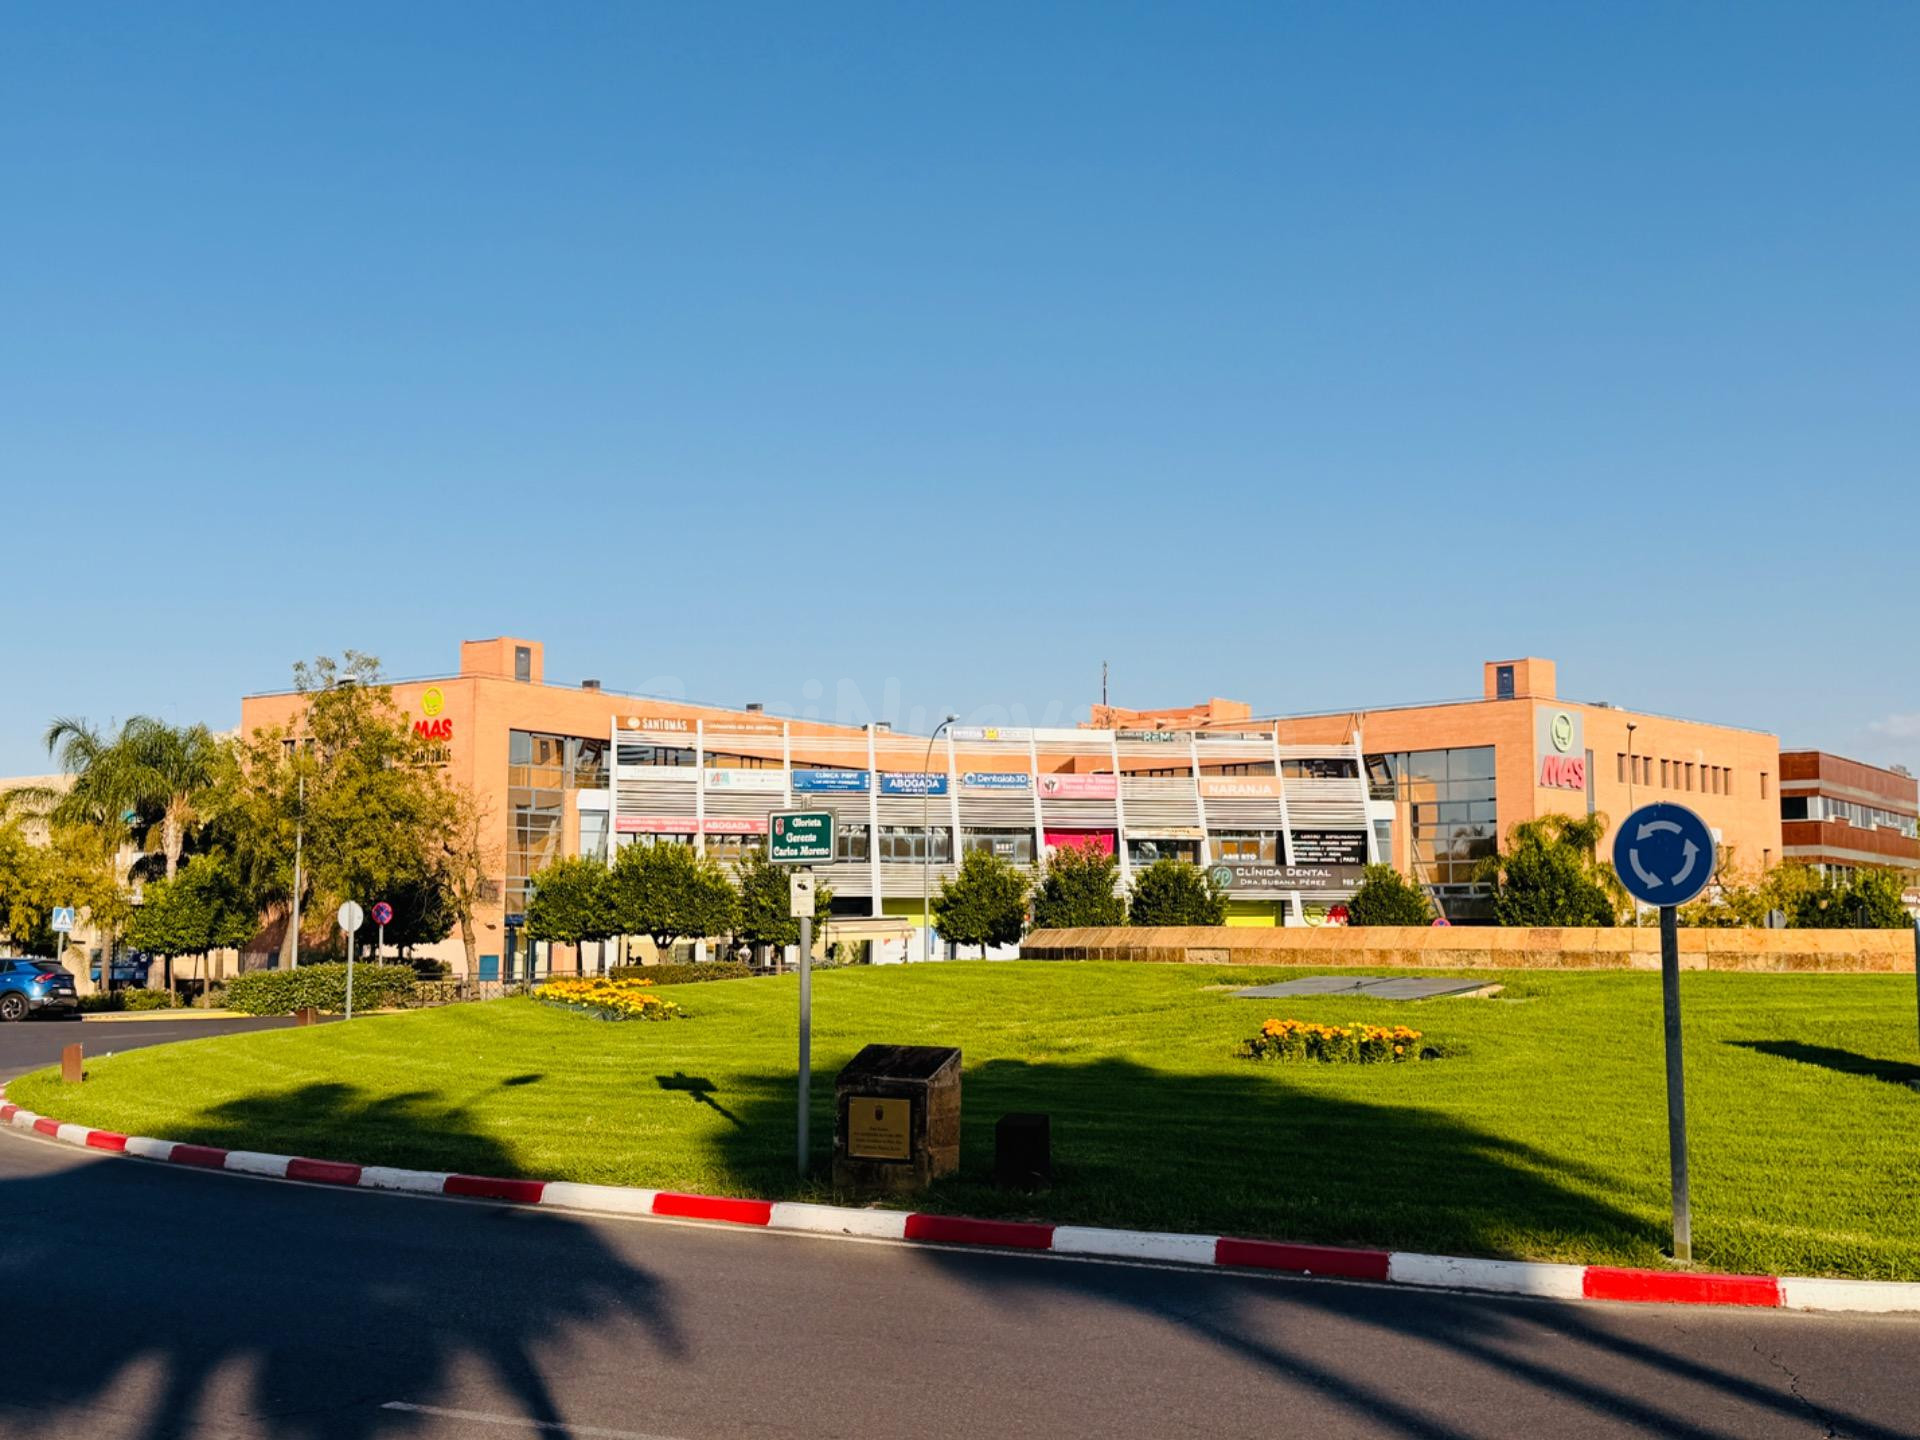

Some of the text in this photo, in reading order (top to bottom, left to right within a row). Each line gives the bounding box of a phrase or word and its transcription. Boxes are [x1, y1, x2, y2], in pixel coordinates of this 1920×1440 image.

[1541, 755, 1584, 789] MAS
[889, 778, 940, 788] ABOGADA
[1208, 784, 1272, 795] NARANJA
[792, 817, 822, 828] Glorieta
[786, 832, 817, 843] Gerente
[773, 845, 831, 857] Carlos Moreno
[1236, 866, 1332, 877] CLÍNICA DENTAL
[1299, 878, 1327, 887] PÉREZ
